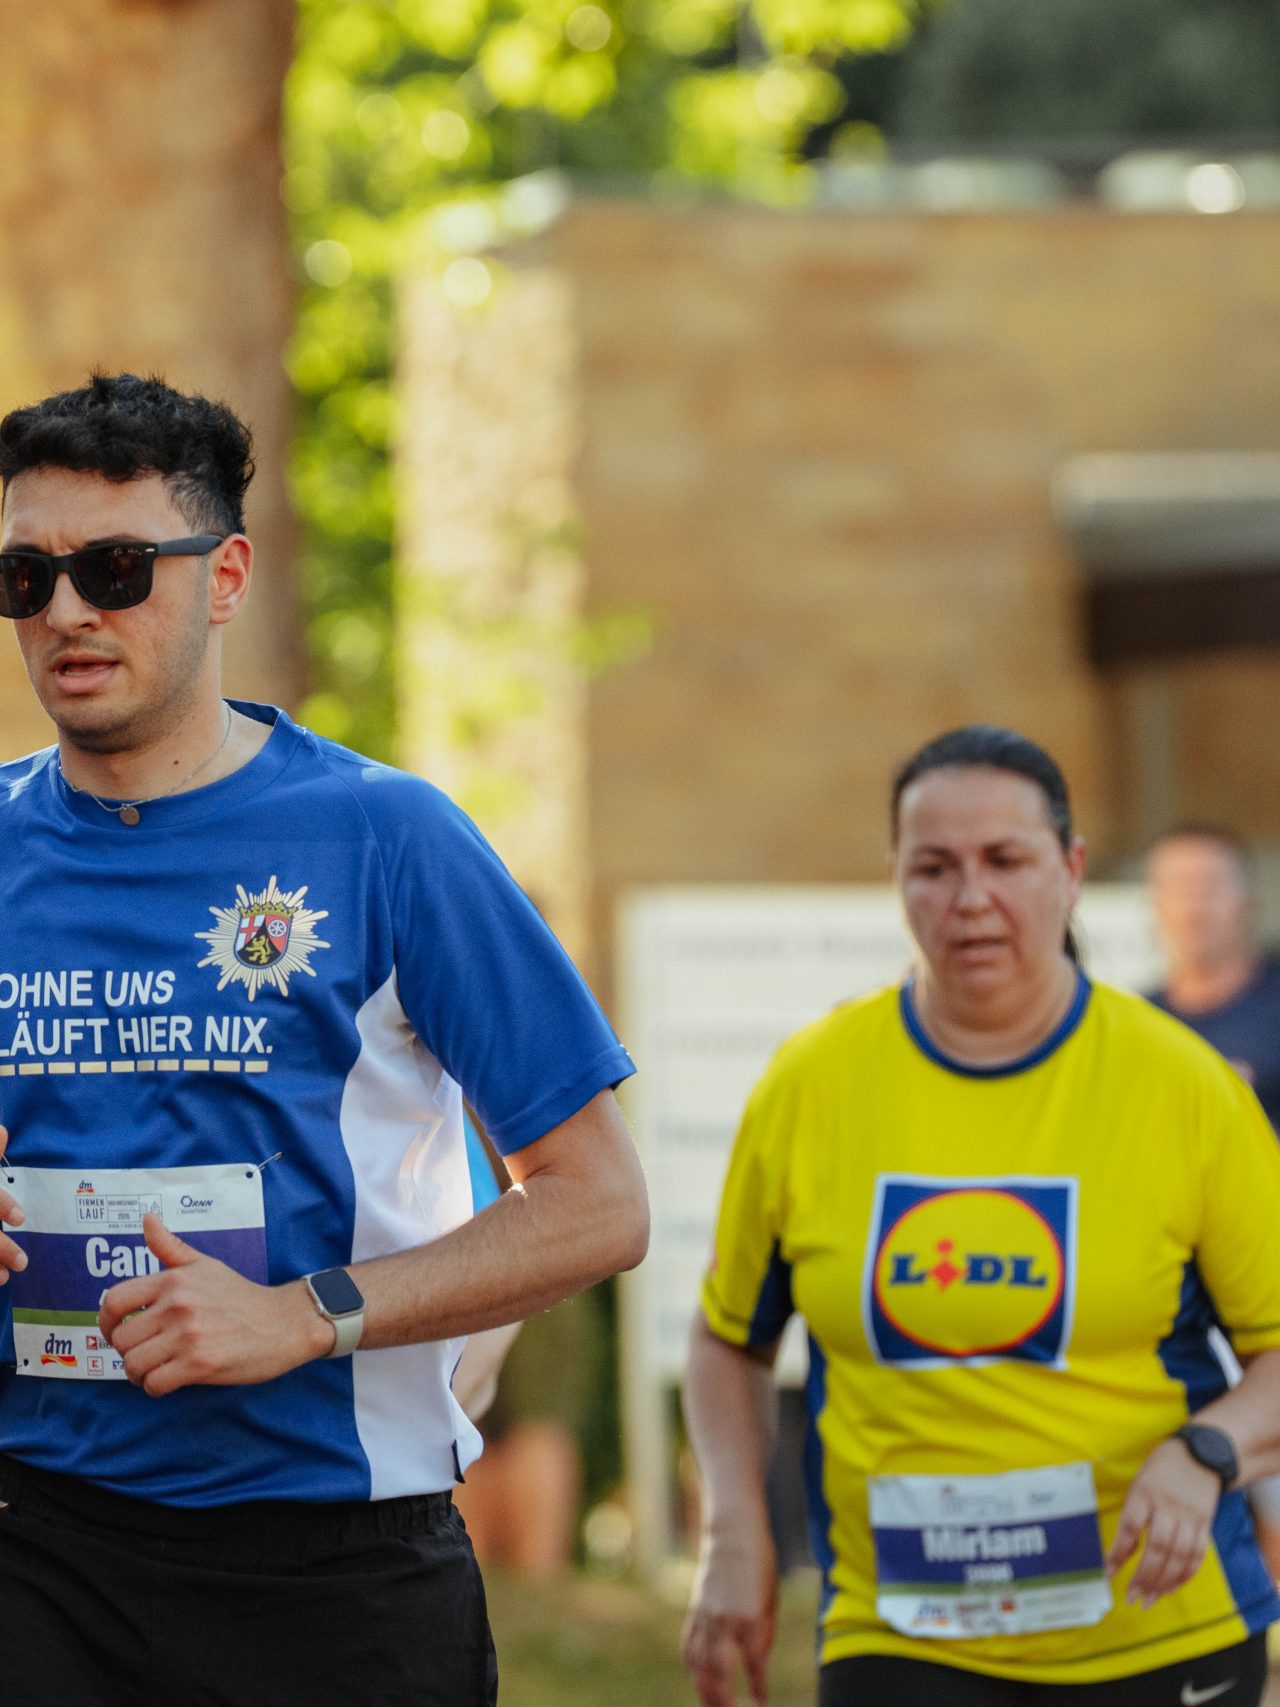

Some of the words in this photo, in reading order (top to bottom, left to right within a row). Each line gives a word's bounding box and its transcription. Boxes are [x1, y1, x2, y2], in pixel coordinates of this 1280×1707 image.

[104, 970, 176, 1007] UNS
[117, 1015, 193, 1054] HIER
[204, 1015, 273, 1054] NIX.
[78, 1198, 105, 1207] FIRMEN
[79, 1208, 105, 1220] LAUF
[85, 1236, 162, 1278] Can
[44, 1332, 73, 1355] dm
[921, 1521, 1048, 1563] Miriam
